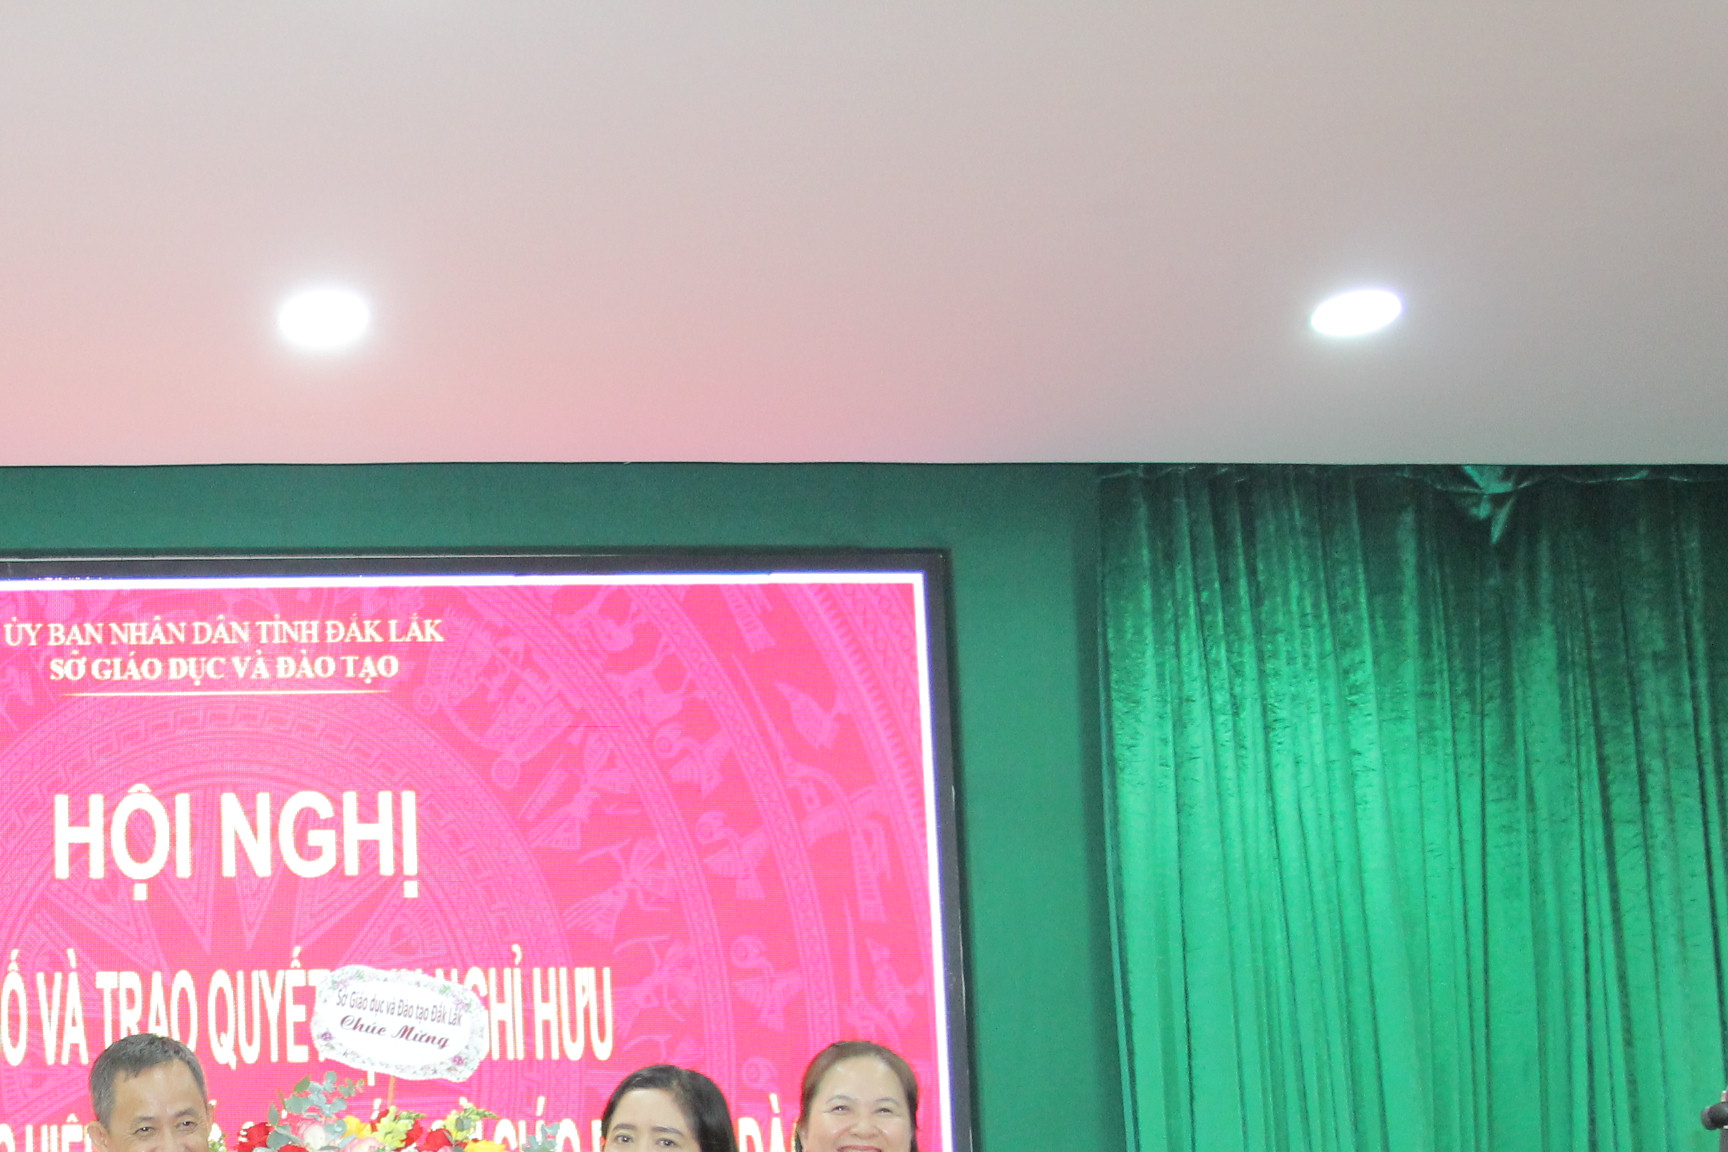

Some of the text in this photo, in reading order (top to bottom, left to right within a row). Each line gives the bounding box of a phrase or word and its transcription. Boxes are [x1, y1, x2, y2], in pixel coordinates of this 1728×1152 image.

[3, 612, 444, 646] ỦY BAN NHÂN DÂN TỈNH ĐẮK LẮK
[50, 649, 399, 686] SỞ GIÁO DỤC VÀ ĐÀO TẠO
[54, 783, 419, 900] HỘI NGHỊ
[36, 948, 89, 1065] VÀ
[95, 969, 199, 1053] TRAO
[533, 966, 614, 1061] HƯU
[340, 1014, 387, 1036] Chúc
